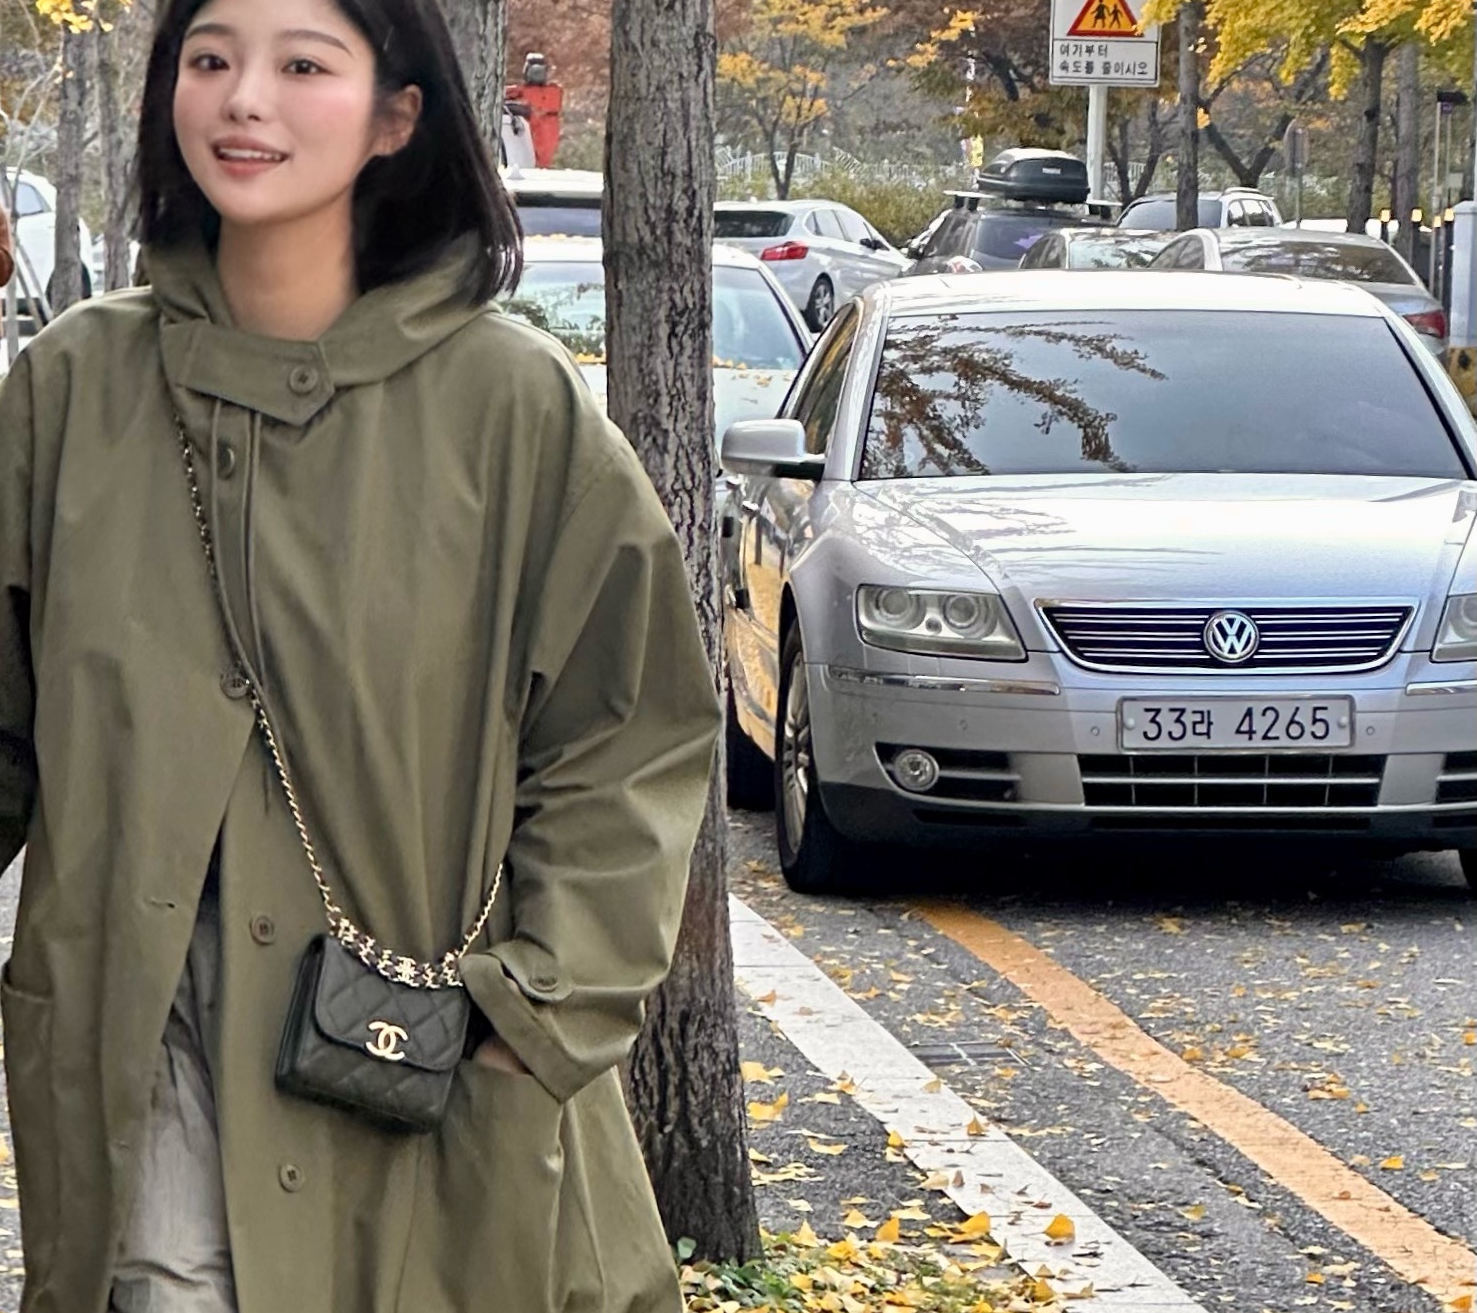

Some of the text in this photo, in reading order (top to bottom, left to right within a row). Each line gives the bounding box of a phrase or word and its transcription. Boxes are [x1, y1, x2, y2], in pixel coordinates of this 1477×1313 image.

[1060, 43, 1108, 57] 여기부터
[1060, 60, 1148, 75] 속도를 줄이시오
[1143, 706, 1330, 741] 33라 4265
